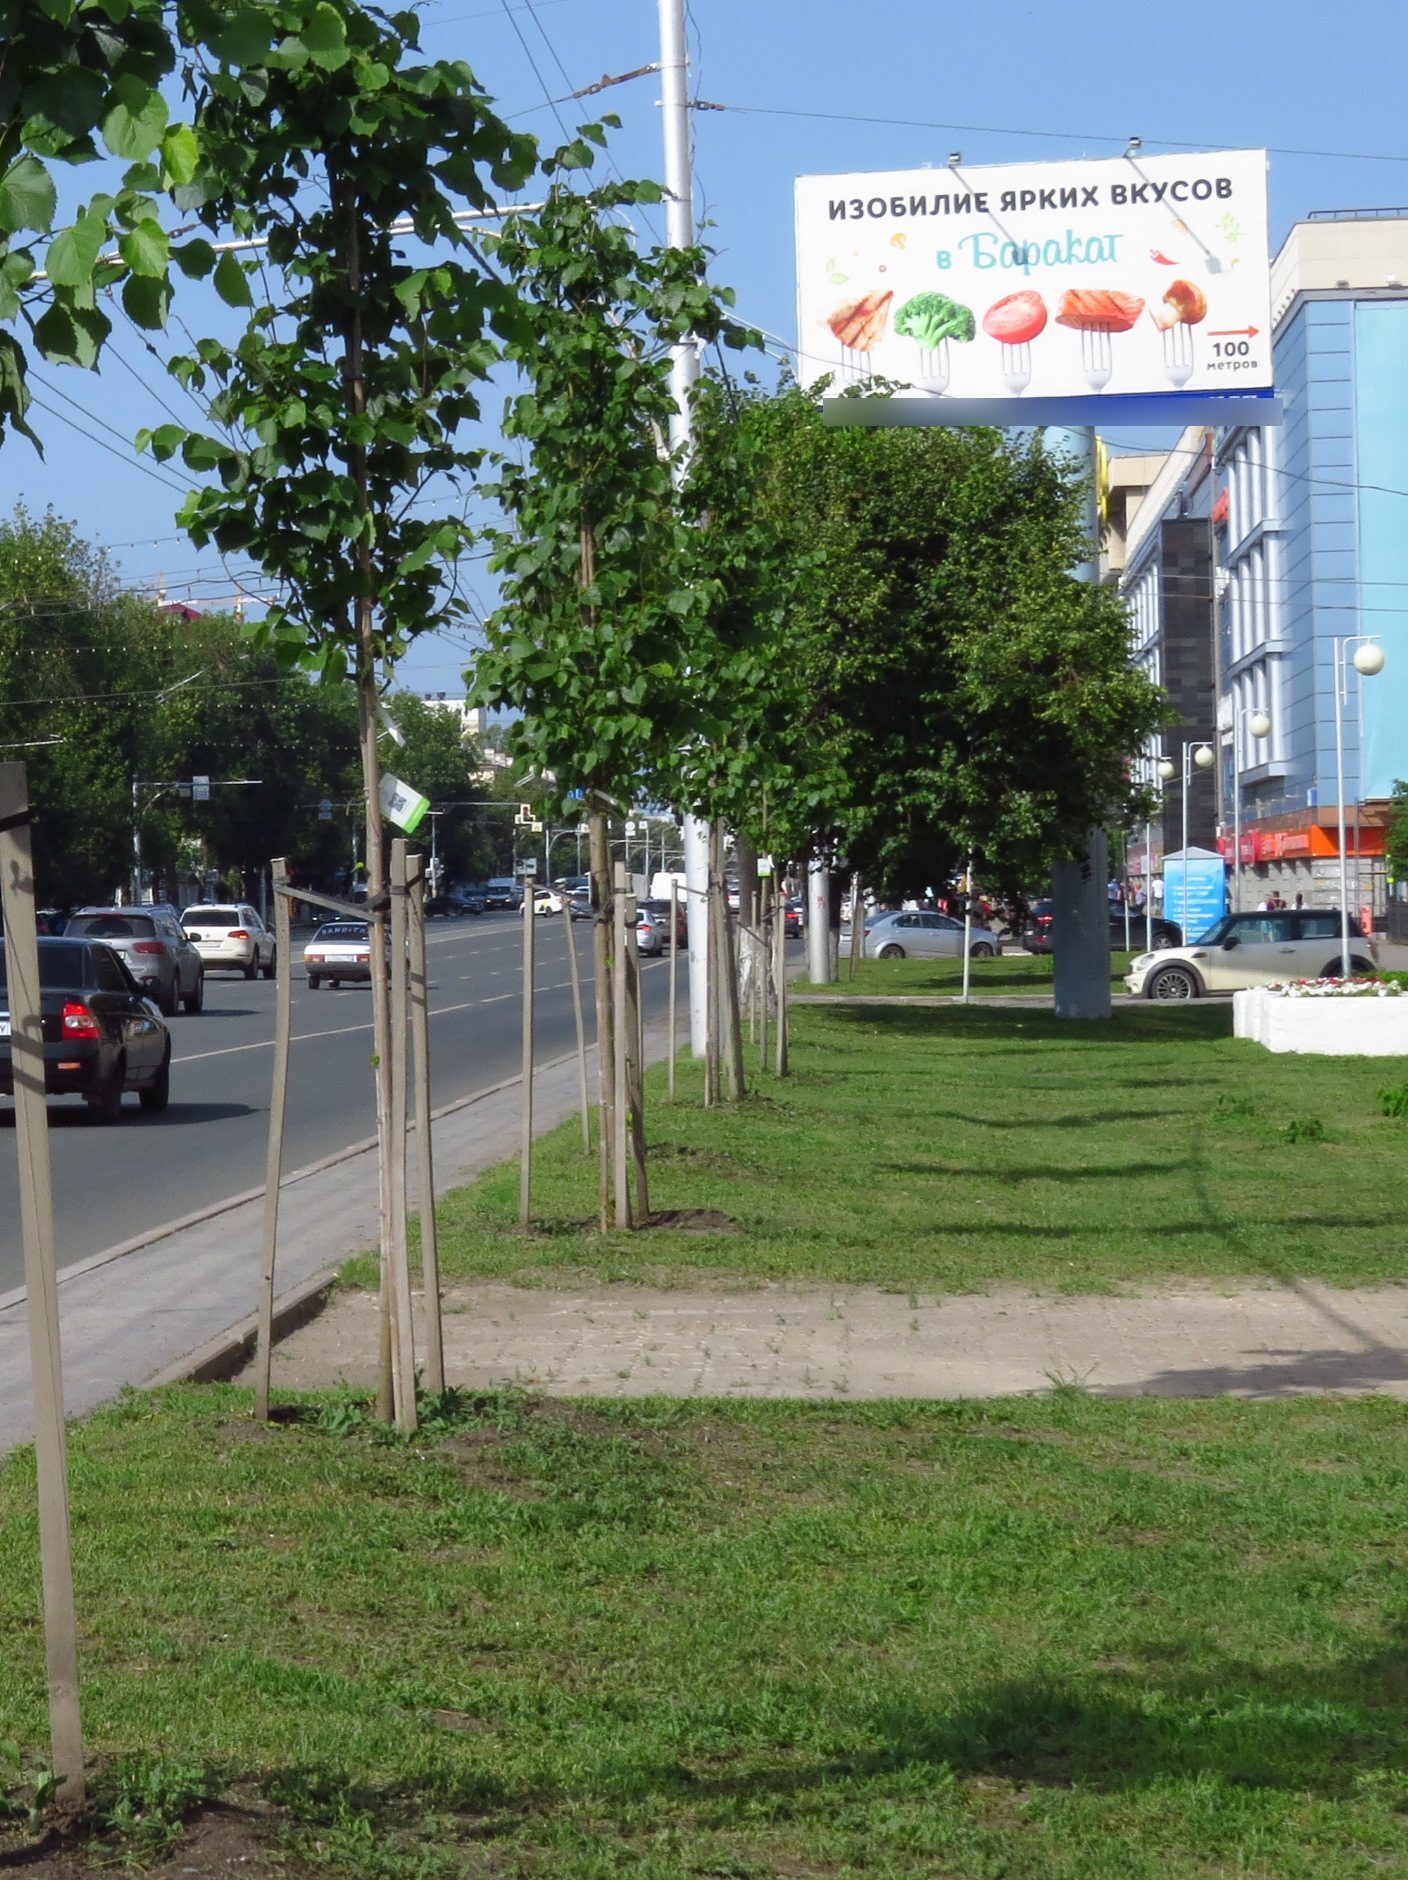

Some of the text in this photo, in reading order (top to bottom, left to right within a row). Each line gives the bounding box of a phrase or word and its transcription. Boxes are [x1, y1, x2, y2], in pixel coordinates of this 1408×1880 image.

[828, 177, 1233, 221] ИЗОБИЛИЕ ЯРКИХ ВКУСОВ
[936, 229, 1124, 276] в Баракат
[1213, 341, 1249, 357] 100
[1207, 360, 1258, 372] метров
